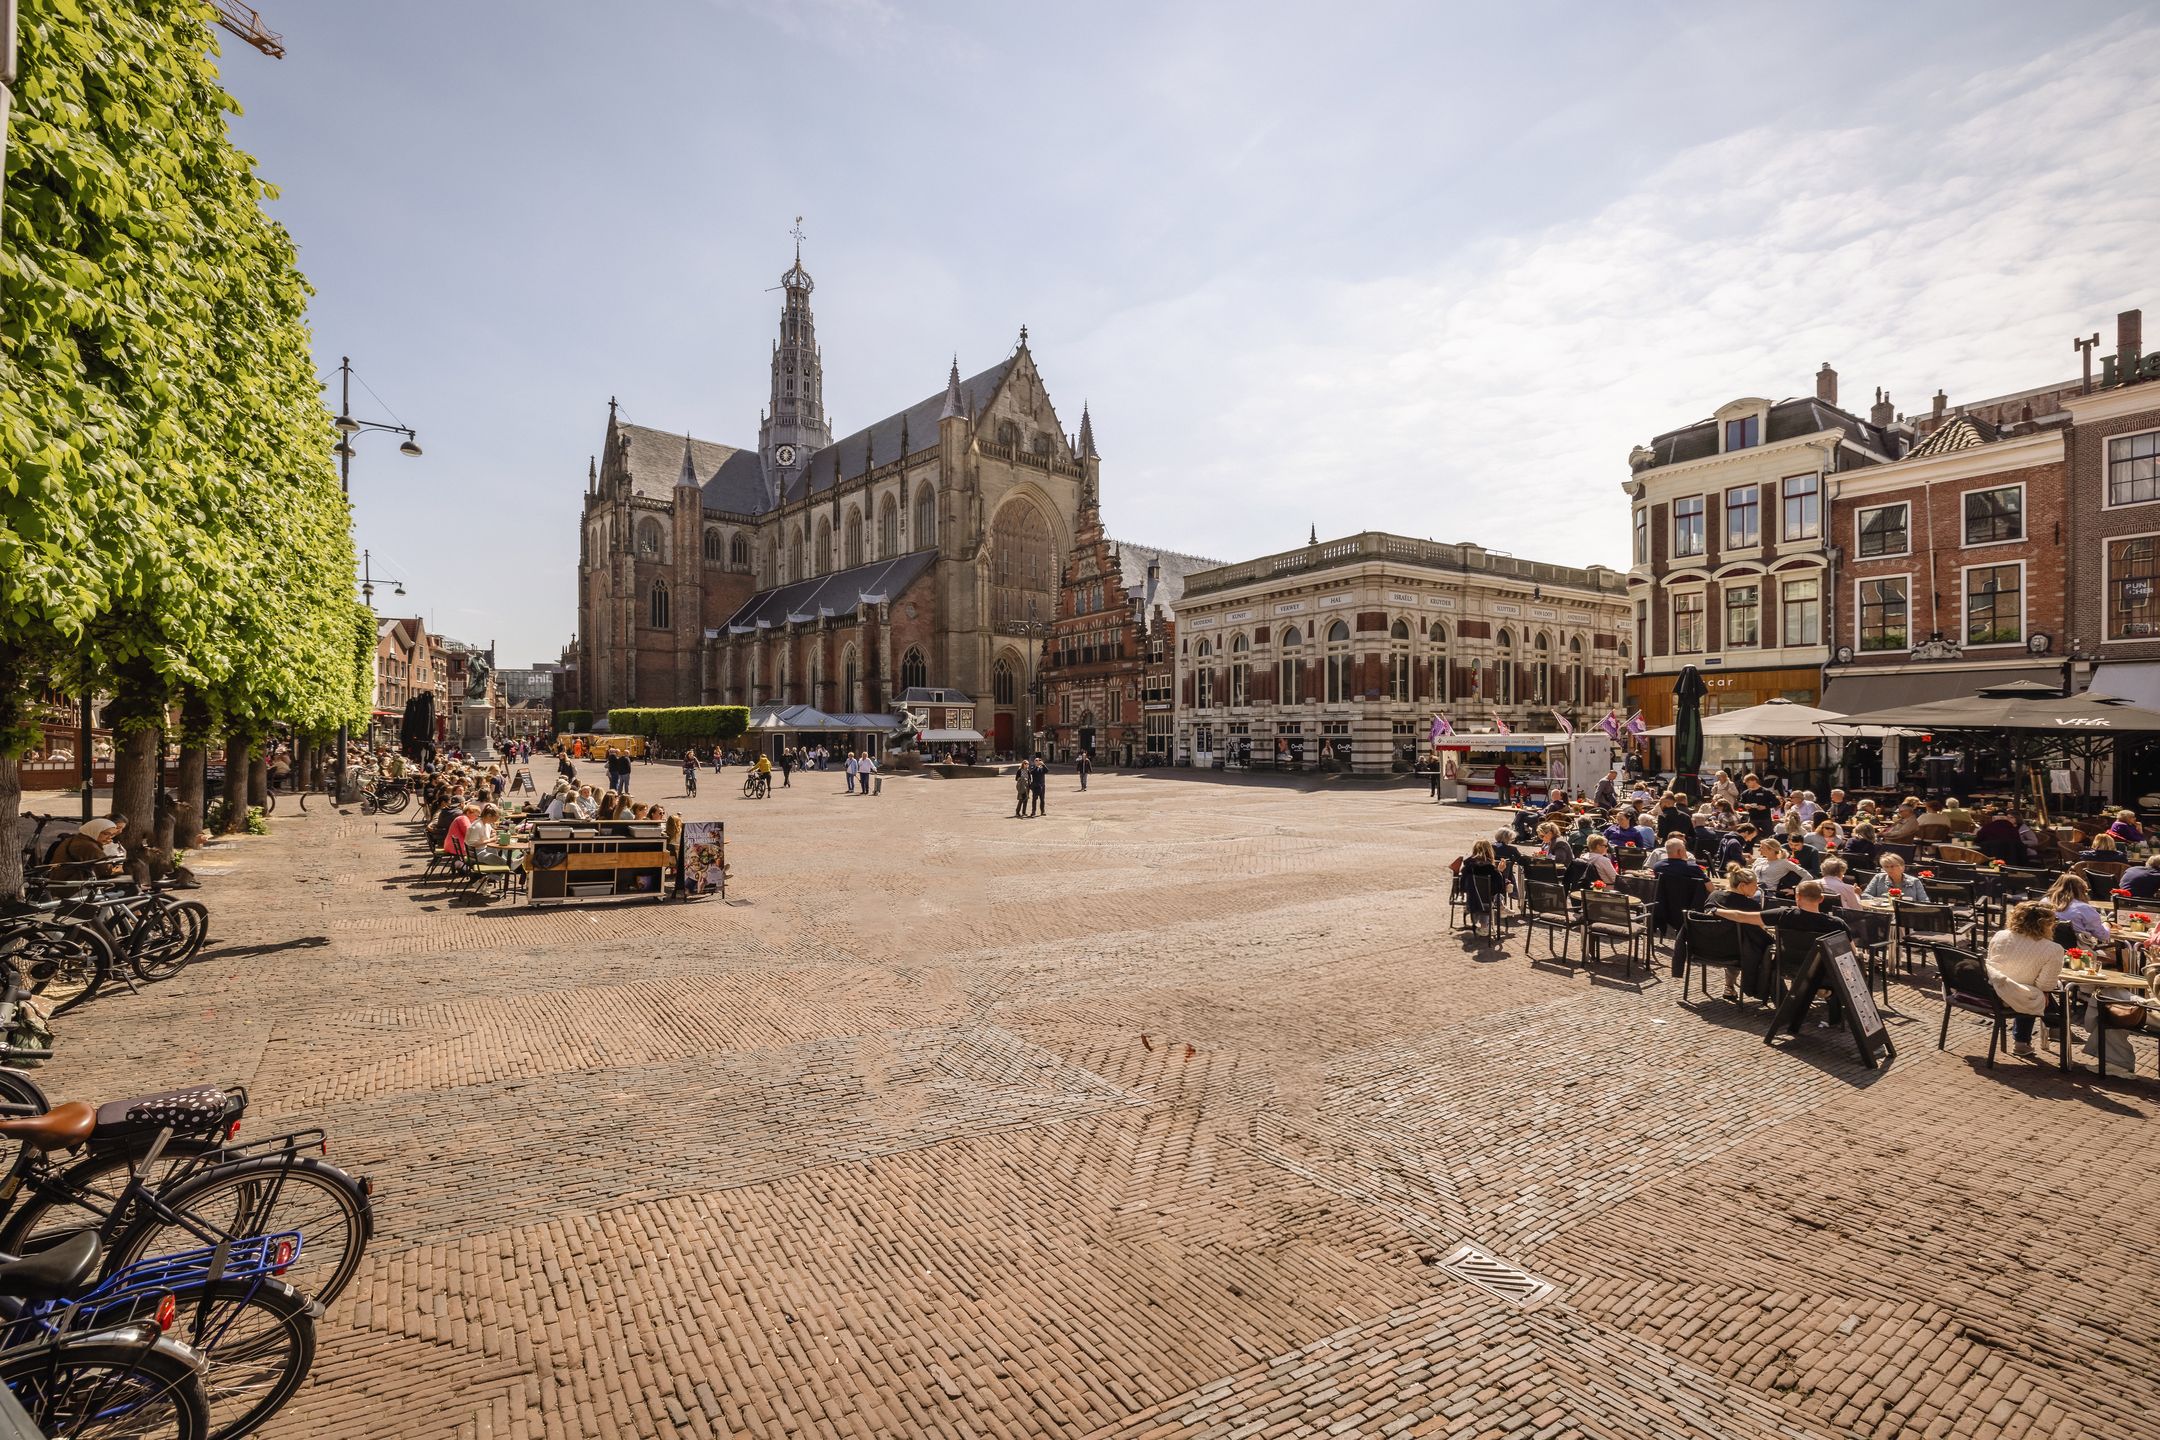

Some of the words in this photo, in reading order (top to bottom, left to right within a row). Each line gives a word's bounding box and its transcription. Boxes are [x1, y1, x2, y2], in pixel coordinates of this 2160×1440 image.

[2125, 582, 2147, 590] PUN
[1232, 612, 1247, 620] KUNST
[1703, 679, 1733, 687] car
